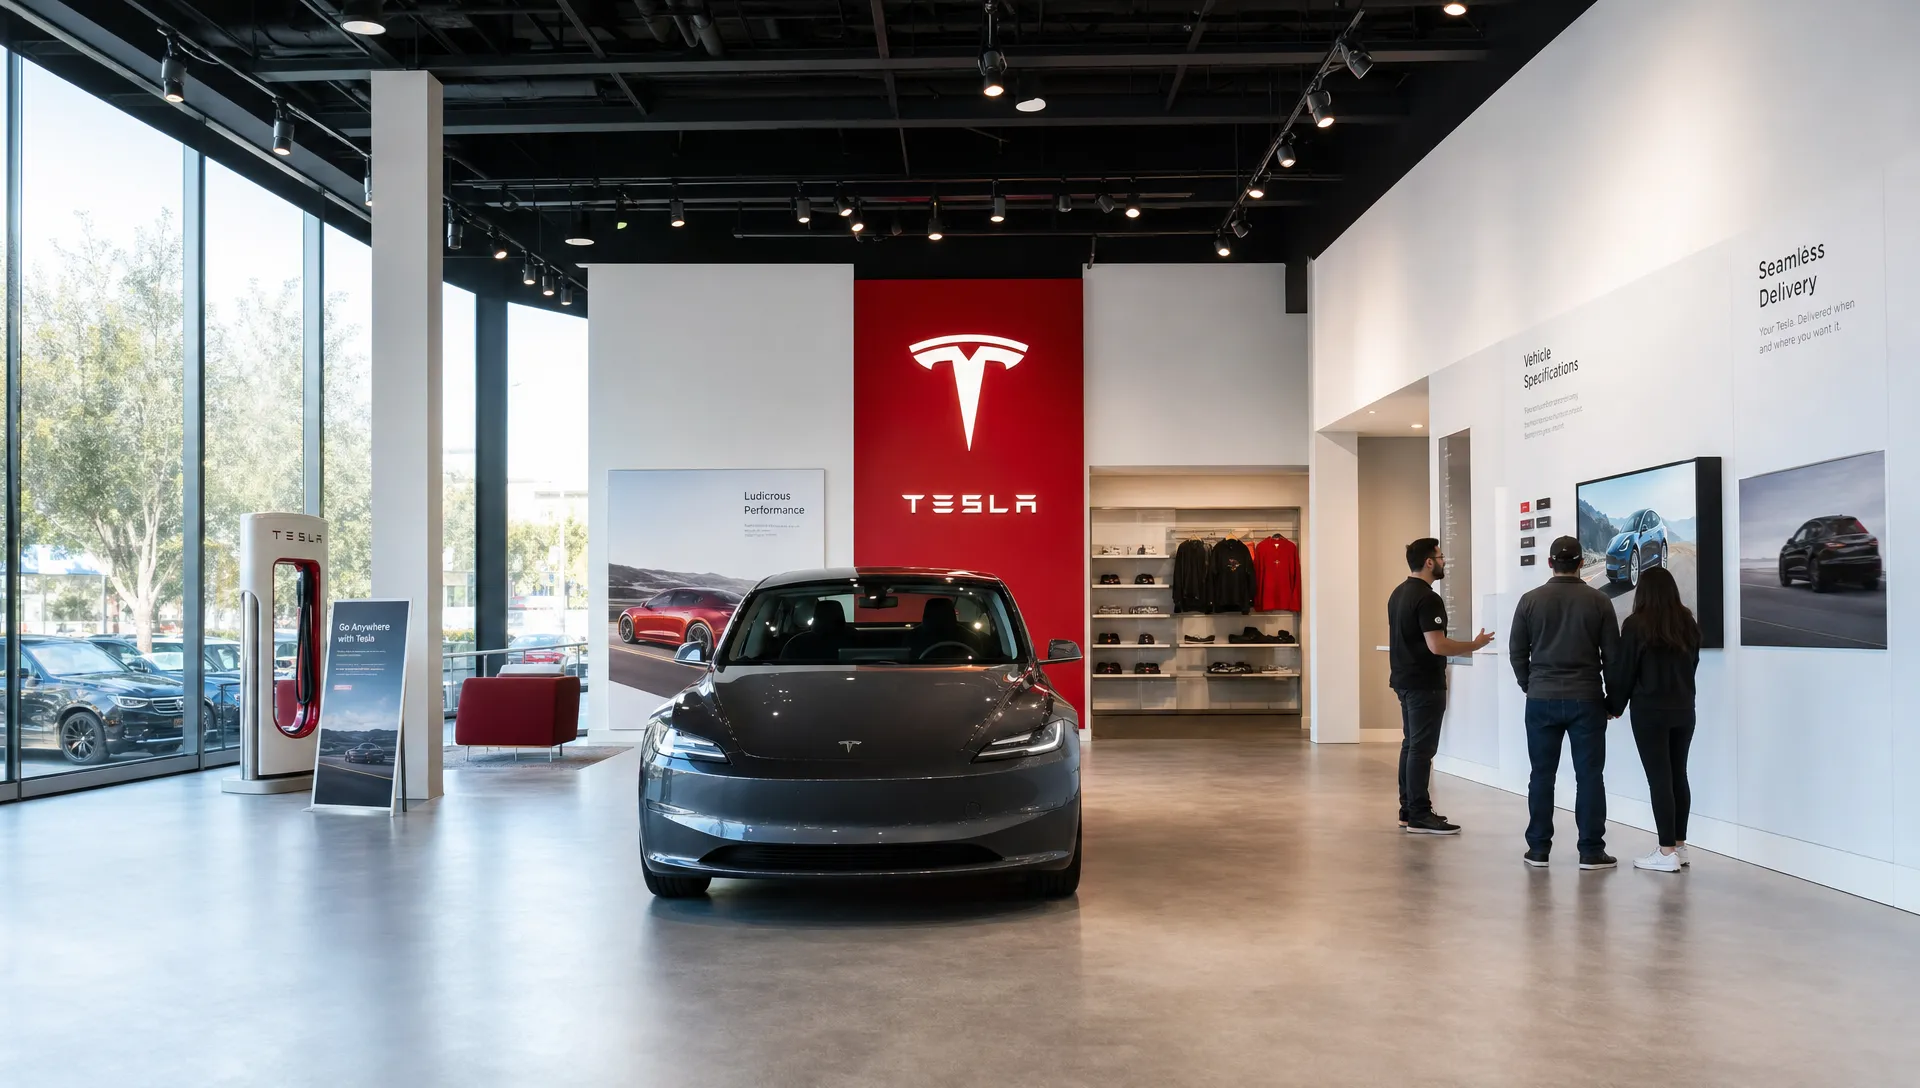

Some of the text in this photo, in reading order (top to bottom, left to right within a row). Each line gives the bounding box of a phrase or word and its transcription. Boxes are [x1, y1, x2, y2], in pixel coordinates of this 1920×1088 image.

[1760, 275, 1817, 308] Delivery
[1759, 325, 1775, 336] Your
[1797, 305, 1832, 325] Delivered
[1833, 299, 1855, 313] when
[1759, 341, 1773, 354] and
[1773, 336, 1796, 349] where
[1797, 332, 1812, 345] you
[1812, 324, 1832, 338] want
[1523, 347, 1551, 367] Vehicle
[1523, 359, 1579, 390] Specifications
[744, 491, 791, 501] Ludicrous
[901, 494, 1037, 514] TESLA
[744, 505, 805, 515] Performance
[272, 530, 323, 544] TESLA
[338, 622, 391, 633] Go Anywhere
[337, 634, 354, 643] with
